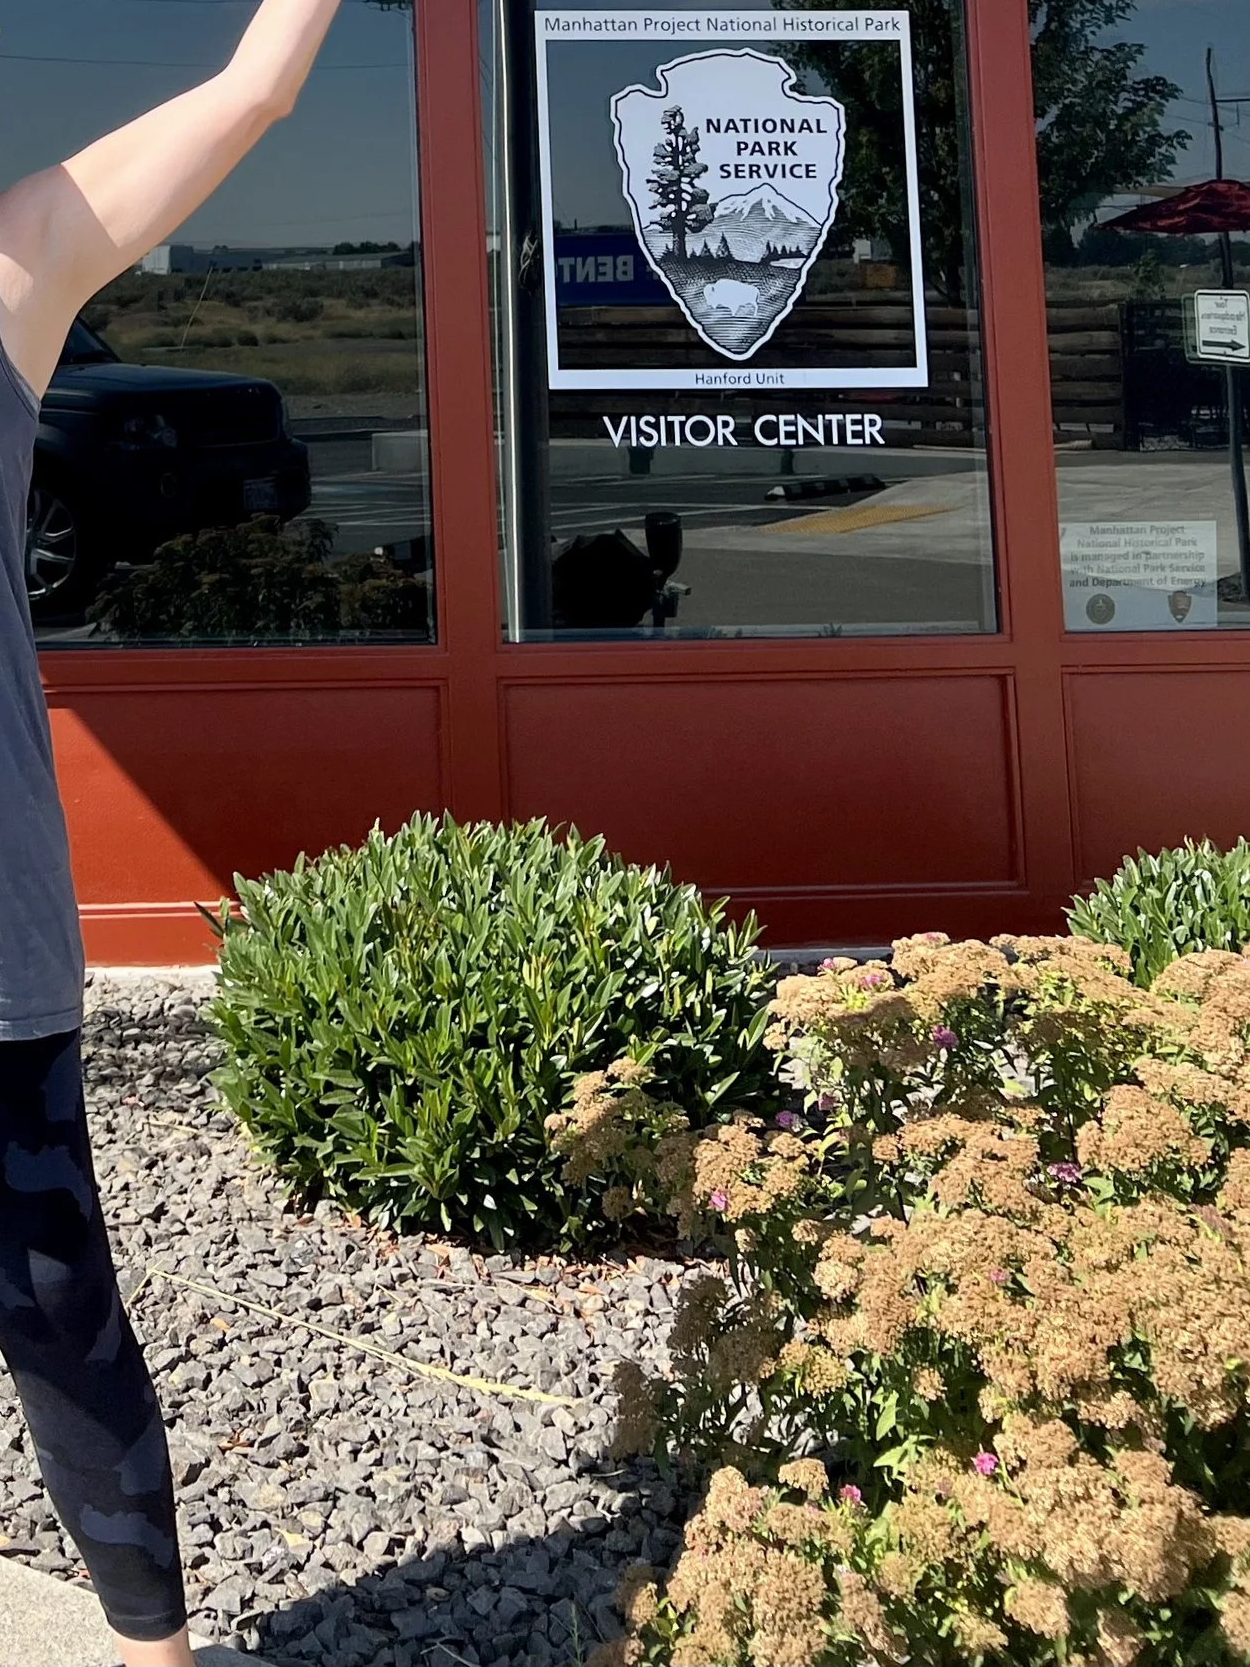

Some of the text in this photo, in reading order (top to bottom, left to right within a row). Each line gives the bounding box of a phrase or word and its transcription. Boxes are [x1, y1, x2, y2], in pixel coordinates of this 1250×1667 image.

[544, 16, 901, 35] Manhattan Project National Historical Park
[706, 118, 828, 134] NATIONAL
[736, 140, 798, 157] PARK
[719, 163, 817, 179] SERVICE
[695, 372, 785, 385] Hanford Unit
[602, 413, 886, 449] VISITOR CENTER
[1089, 524, 1186, 537] Manhattan Project
[1077, 537, 1198, 549] National Historical Park
[1081, 551, 1129, 564] managed
[1132, 551, 1143, 561] in
[1145, 550, 1206, 563] partnership
[1070, 563, 1206, 574] wth National Park Service
[1069, 577, 1089, 588] and
[1157, 576, 1168, 585] of
[1171, 576, 1207, 589] Energy
